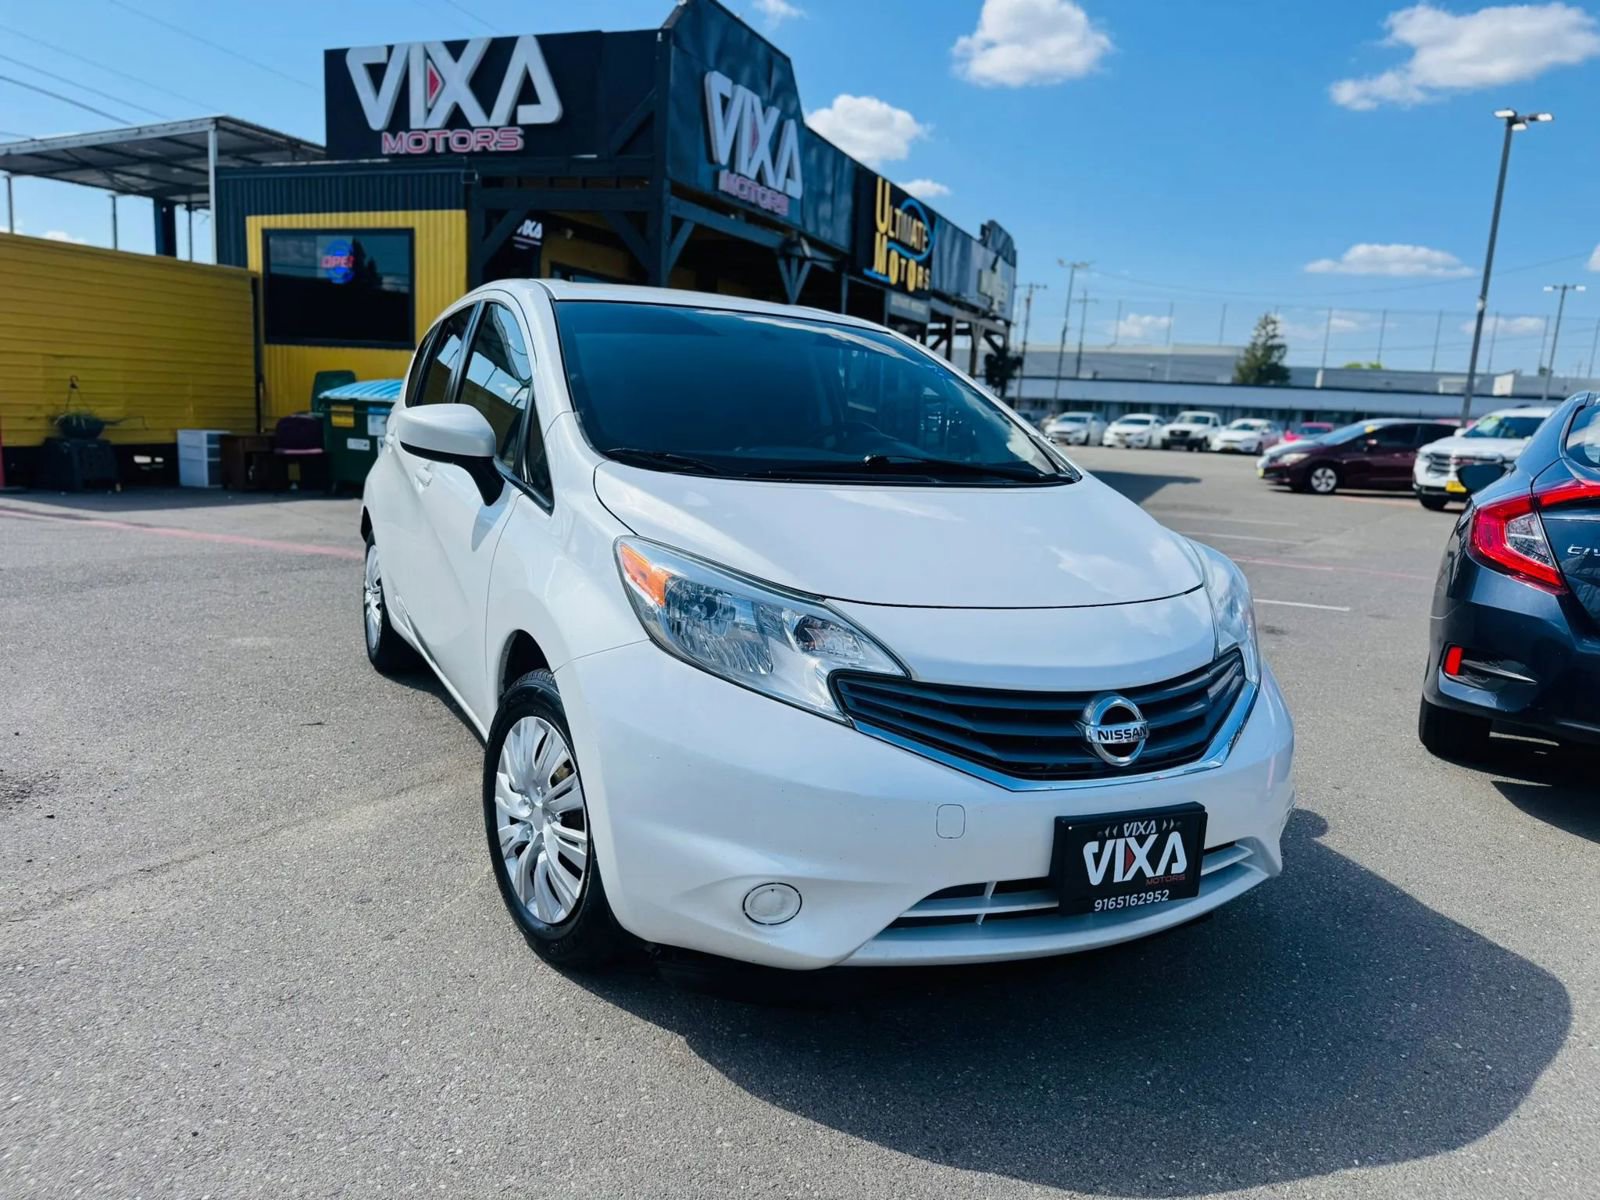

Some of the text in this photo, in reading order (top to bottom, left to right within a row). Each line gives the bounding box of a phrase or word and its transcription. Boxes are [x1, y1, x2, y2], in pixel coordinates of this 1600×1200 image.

[345, 34, 563, 131] VIXA
[381, 126, 524, 155] MOTORS
[704, 70, 803, 199] VIXA
[718, 169, 789, 216] MOTORS
[873, 231, 930, 292] MOTORS
[1097, 725, 1147, 741] NISSAN
[1123, 820, 1157, 837] VIXA
[1083, 831, 1187, 886] VIXA
[1146, 874, 1186, 886] MOTORS
[1094, 889, 1170, 912] 9165162952
